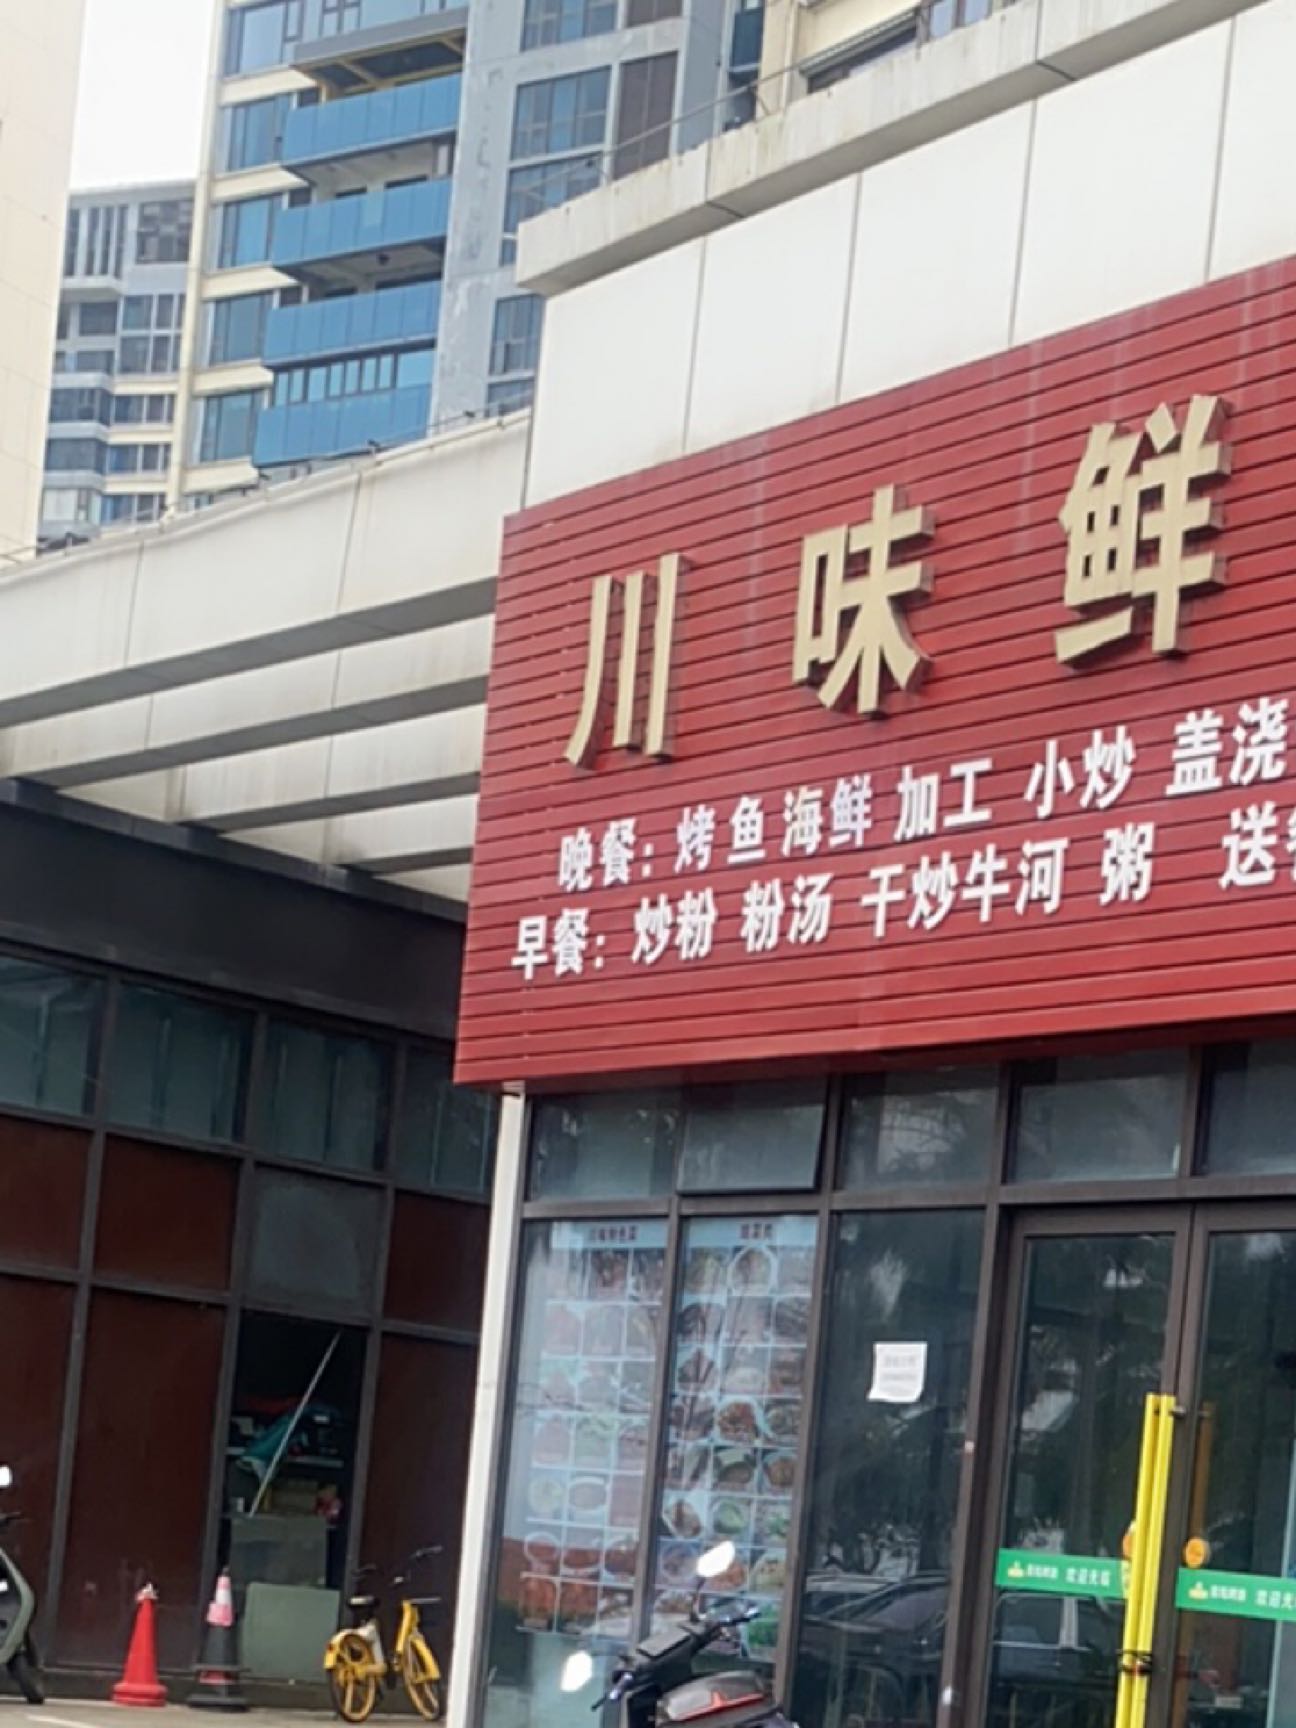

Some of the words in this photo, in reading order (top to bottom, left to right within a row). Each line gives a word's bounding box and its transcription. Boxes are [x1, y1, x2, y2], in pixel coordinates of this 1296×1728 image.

[1021, 724, 1138, 820] 小炒
[738, 871, 835, 954] 粉汤
[857, 835, 1070, 939] 干炒牛河
[1097, 820, 1156, 907] 粥
